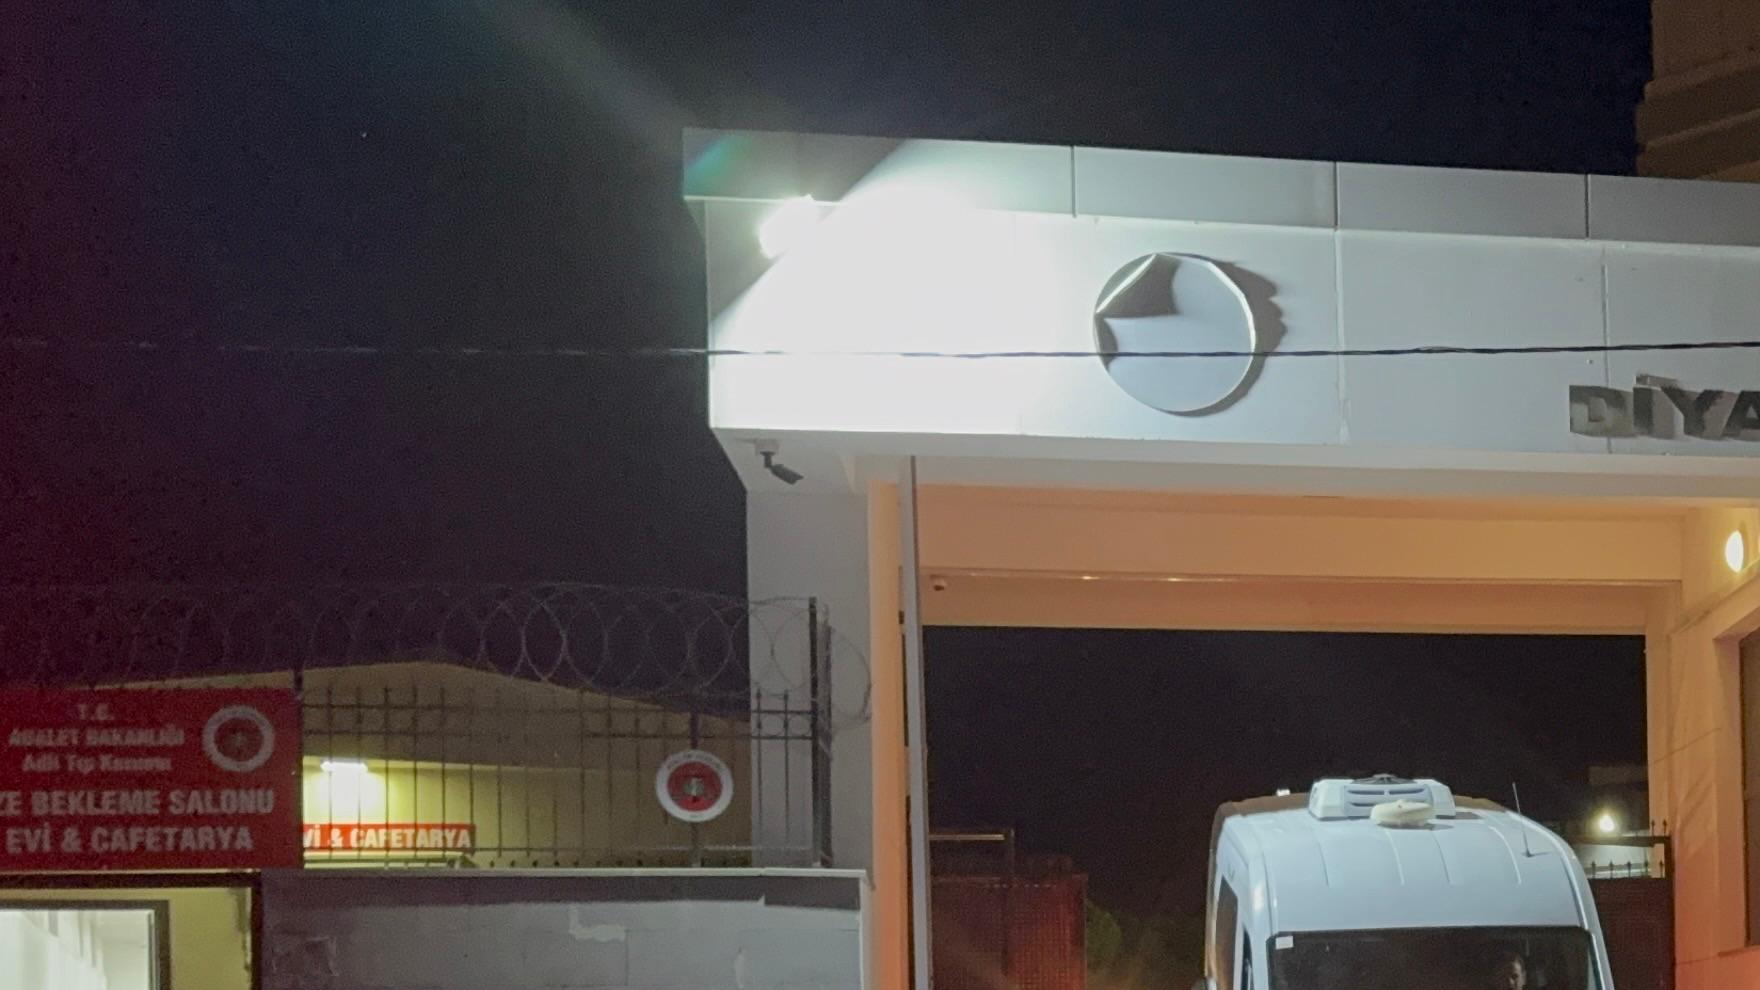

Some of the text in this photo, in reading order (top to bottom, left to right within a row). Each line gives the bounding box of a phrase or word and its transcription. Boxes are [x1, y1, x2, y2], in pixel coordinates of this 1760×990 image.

[30, 789, 161, 816] BEKLEME
[167, 788, 275, 815] SALONU
[5, 821, 254, 854] EVİ & CAFETARYA
[327, 827, 344, 849] &
[350, 827, 473, 849] CAFETARYA
